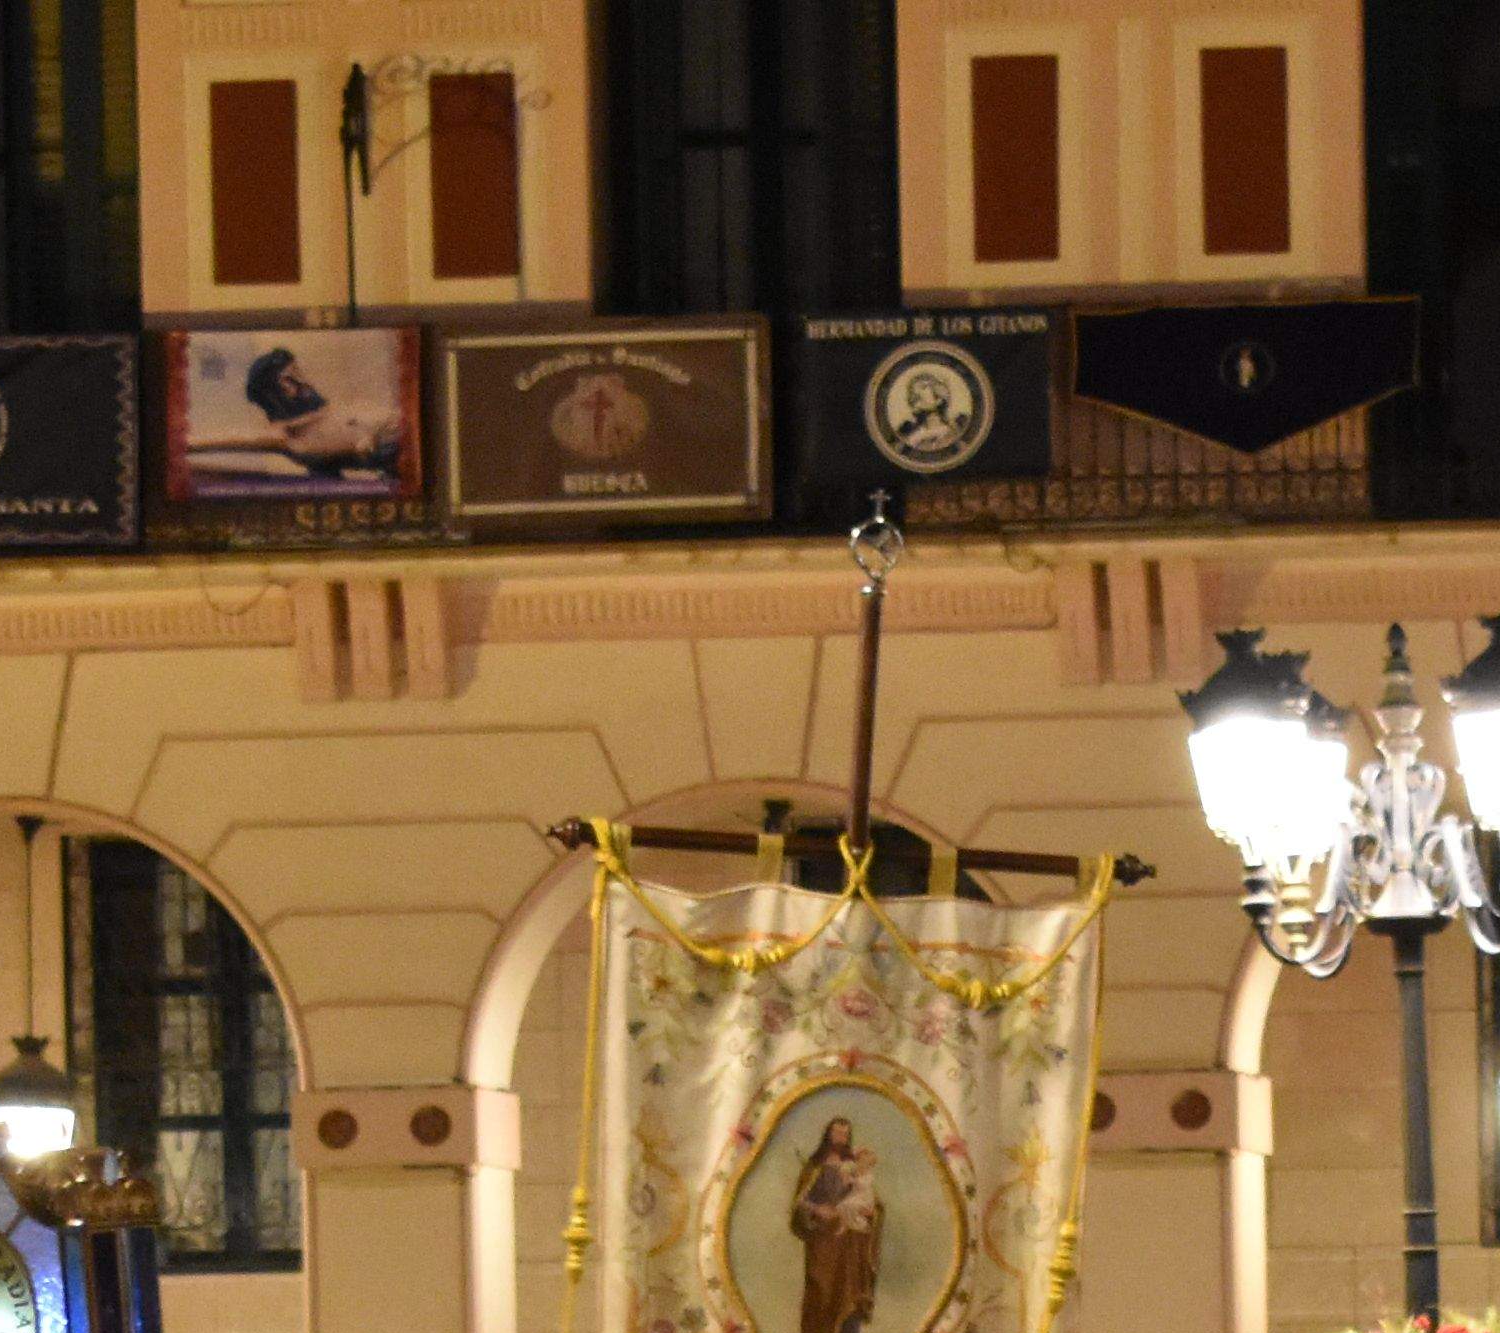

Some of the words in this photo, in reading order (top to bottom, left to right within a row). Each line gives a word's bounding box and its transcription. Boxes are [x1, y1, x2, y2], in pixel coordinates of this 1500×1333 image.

[807, 318, 908, 339] HERMANDAD
[914, 316, 934, 336] DE
[942, 316, 974, 335] LOS
